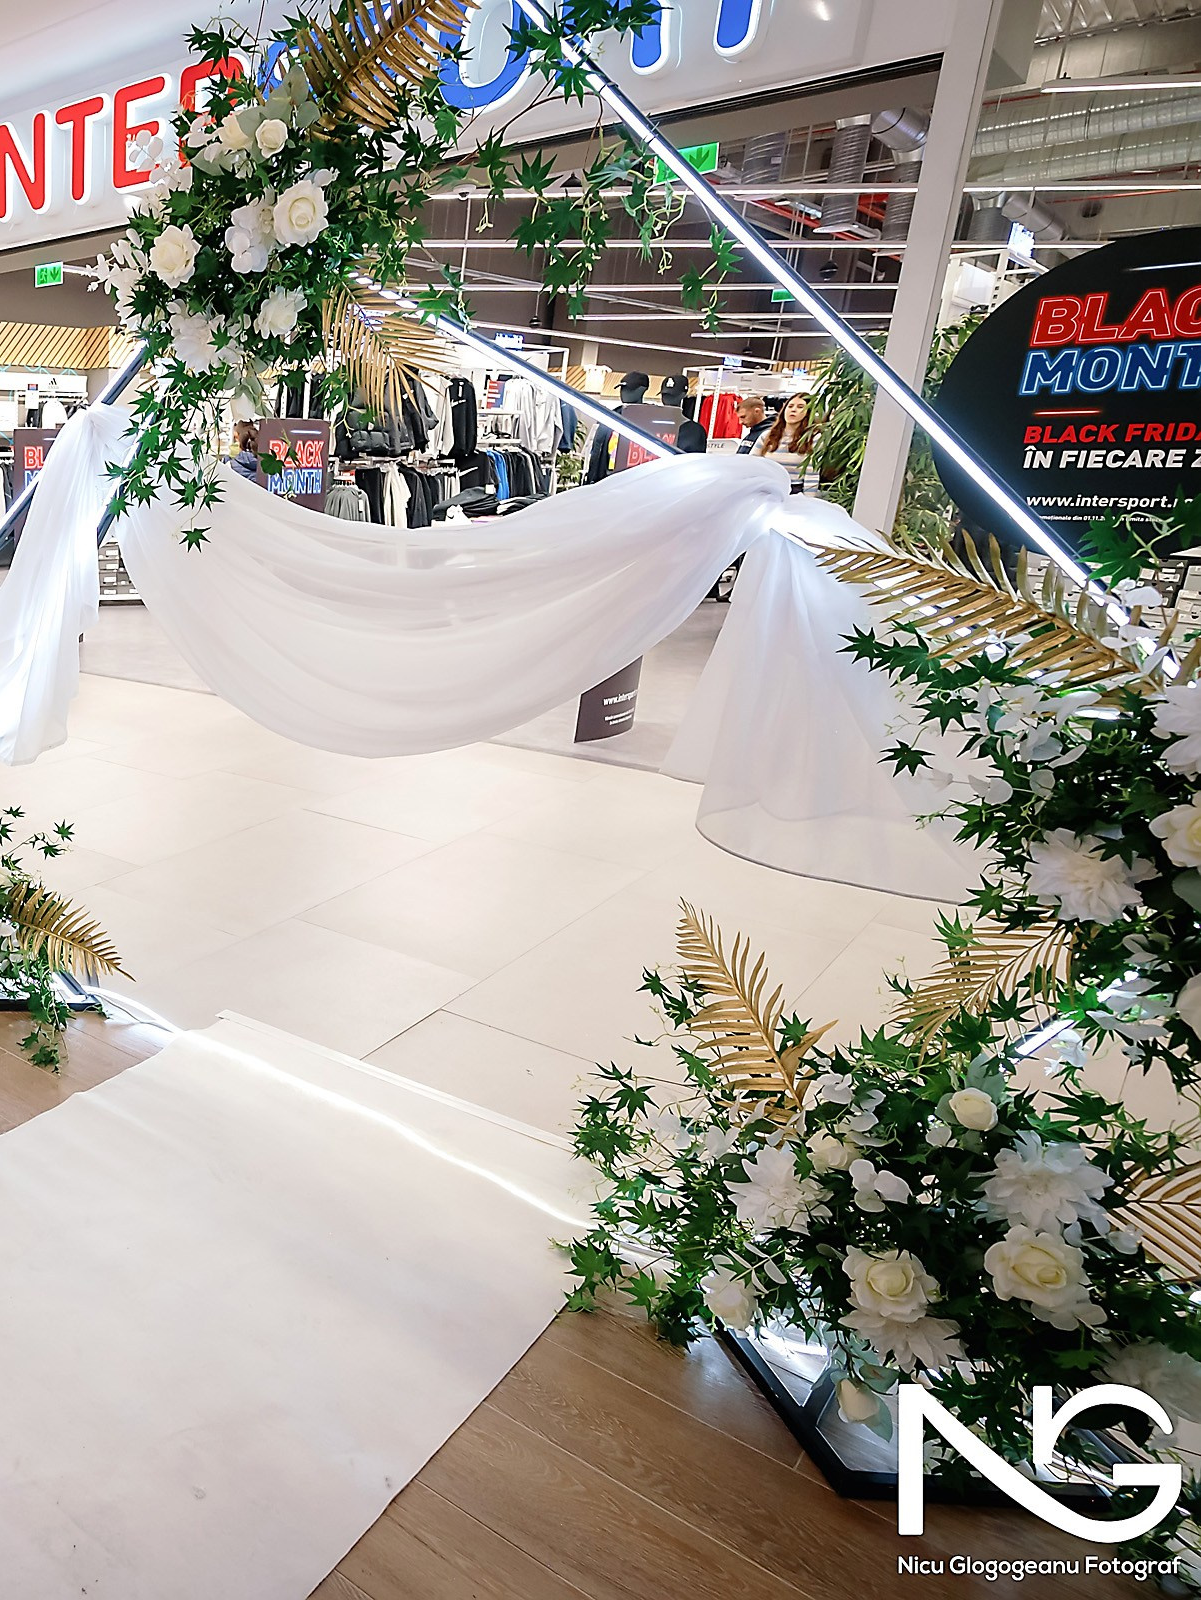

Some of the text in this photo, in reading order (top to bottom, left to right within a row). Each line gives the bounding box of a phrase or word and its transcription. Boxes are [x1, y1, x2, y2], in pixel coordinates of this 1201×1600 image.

[1029, 284, 1201, 347] BLAC
[1019, 342, 1201, 395] MONT
[1023, 422, 1201, 444] BLACK FRID
[1023, 446, 1053, 469] ÎN
[1059, 449, 1187, 469] FIECARE
[267, 468, 323, 494] MONTH
[1026, 494, 1195, 511] www.intersport.r
